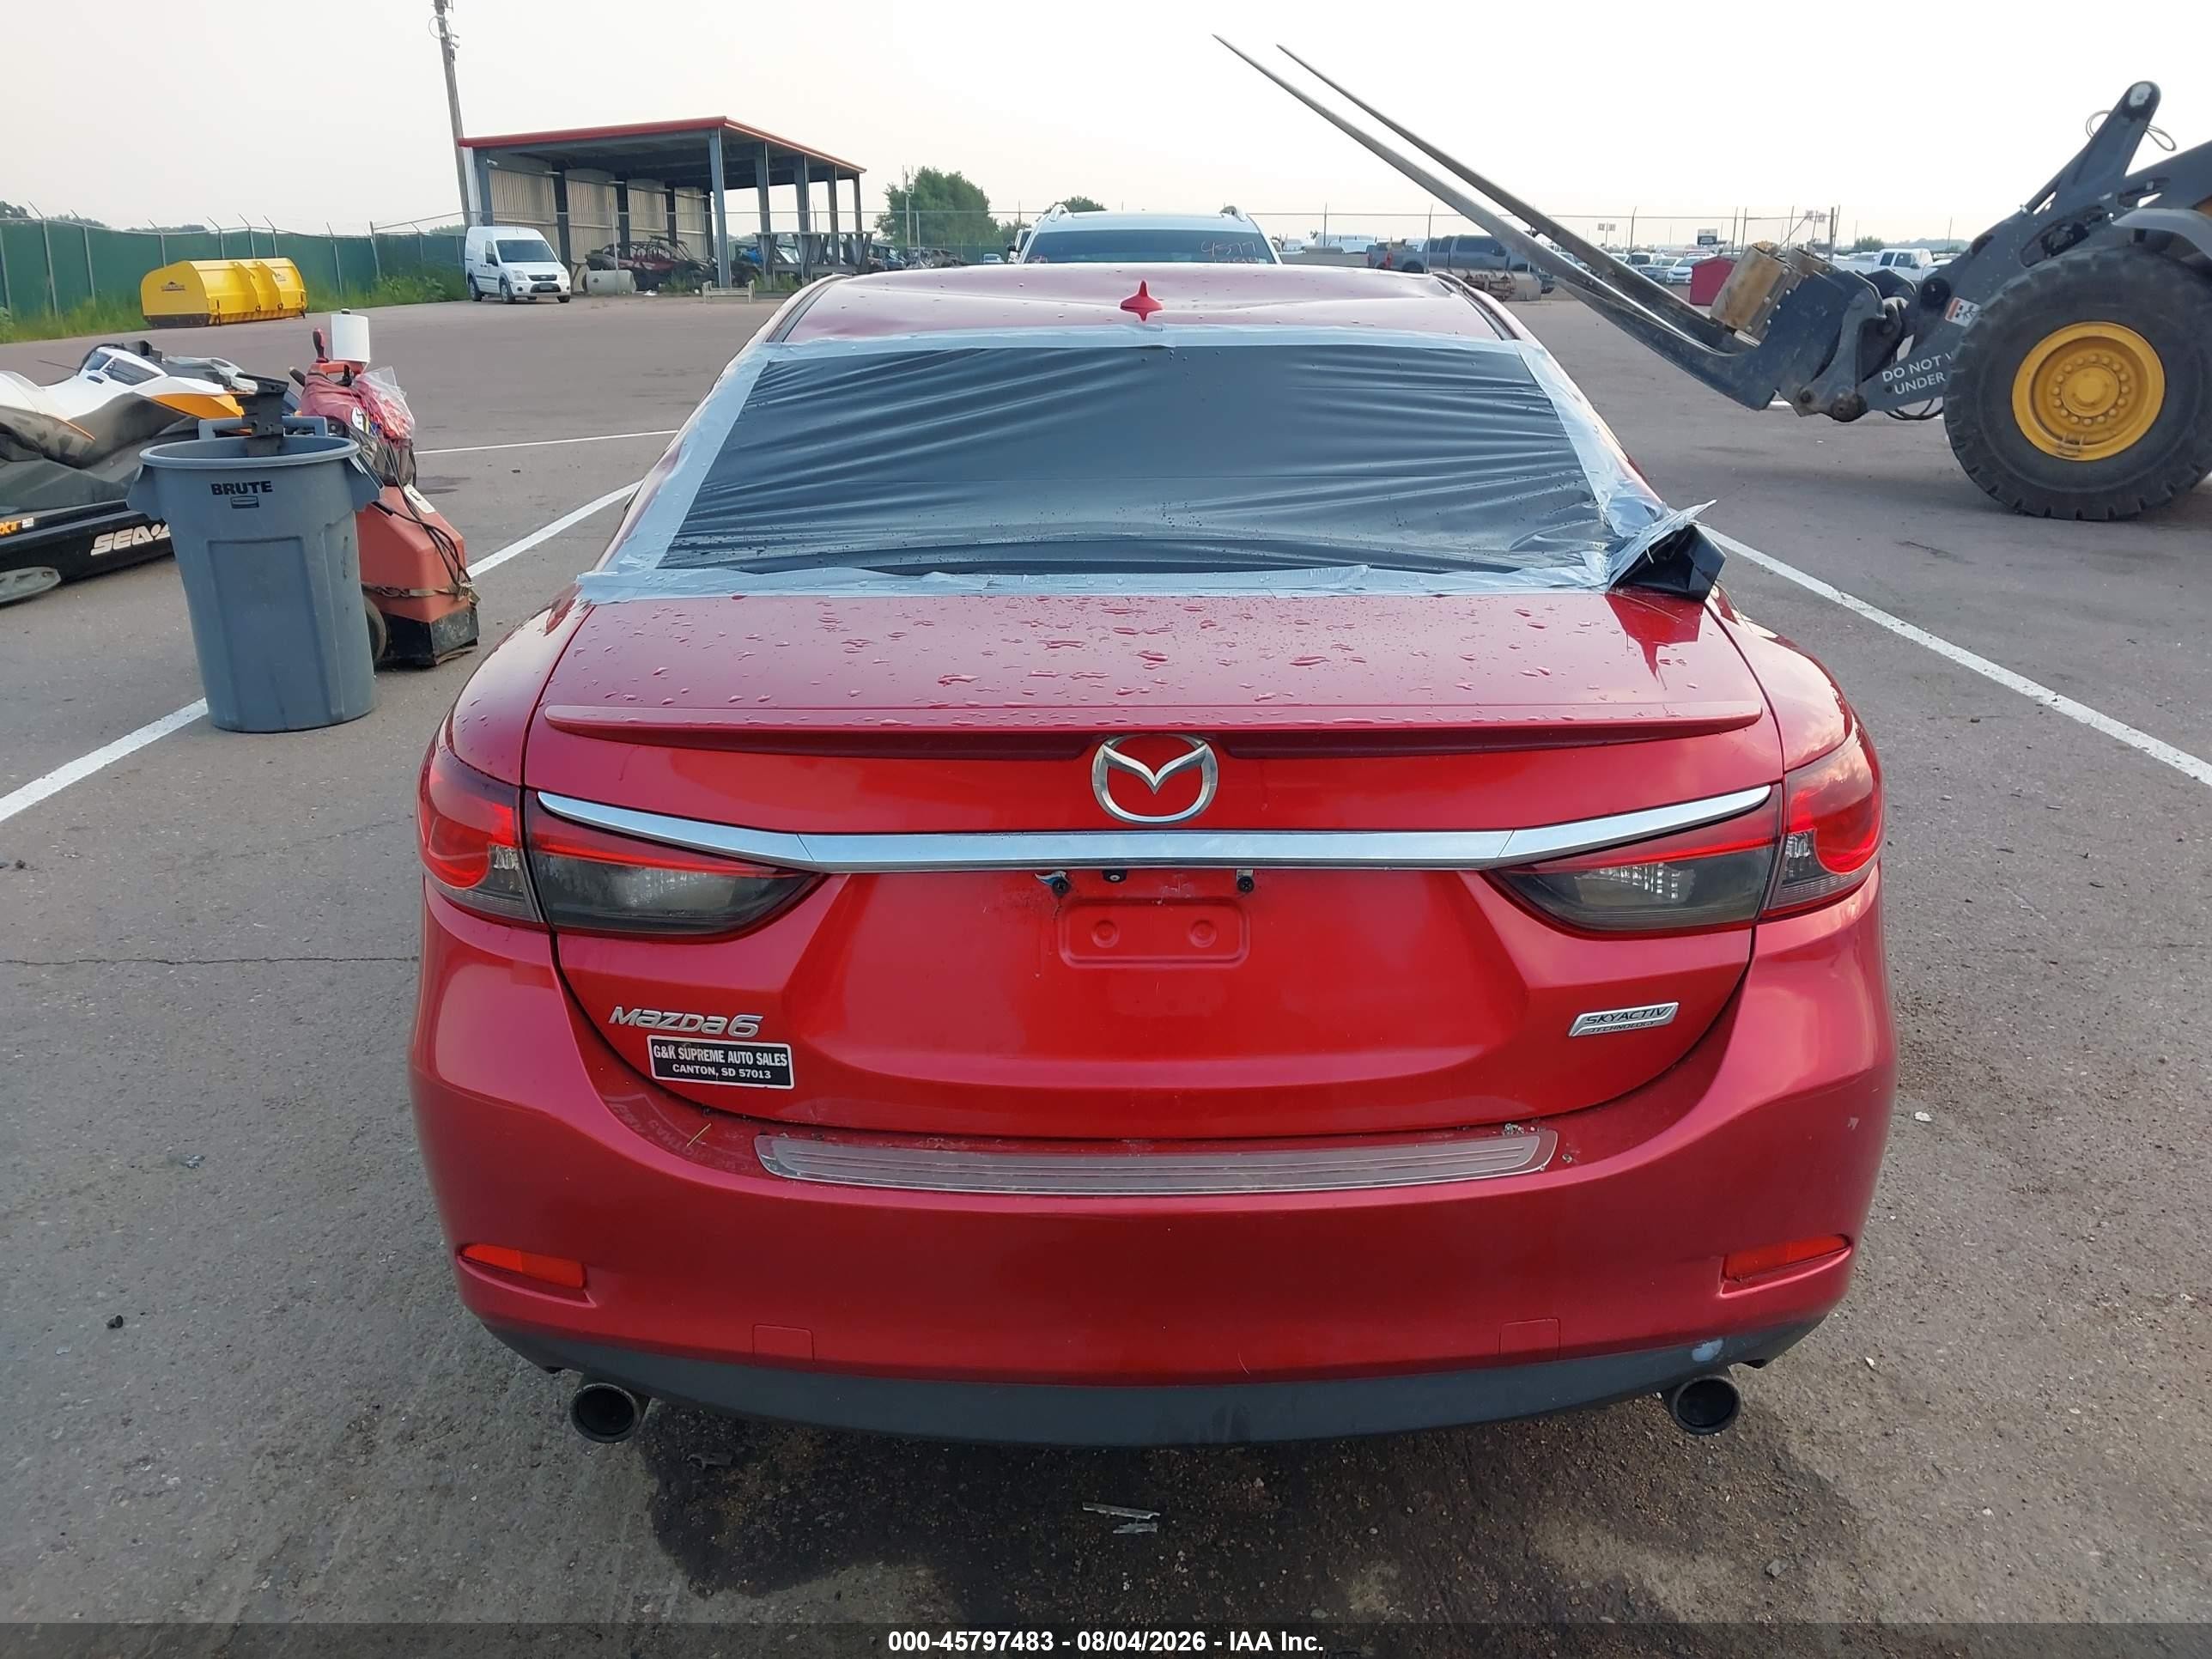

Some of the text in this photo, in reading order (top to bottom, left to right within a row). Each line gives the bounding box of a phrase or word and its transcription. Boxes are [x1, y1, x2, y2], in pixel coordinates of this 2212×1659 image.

[1881, 367, 1905, 382] DO
[1908, 355, 1942, 374] NOT
[1894, 371, 1947, 395] UNDER
[210, 480, 273, 495] BRUTE
[1583, 1006, 1668, 1025] SKYACTIV
[1589, 1020, 1656, 1033] TECHNOLOGY
[678, 1046, 726, 1063] SUPREME
[727, 1050, 754, 1065] AUTO
[756, 1052, 788, 1066] SALES
[672, 1063, 772, 1079] CANTON, SD 57013
